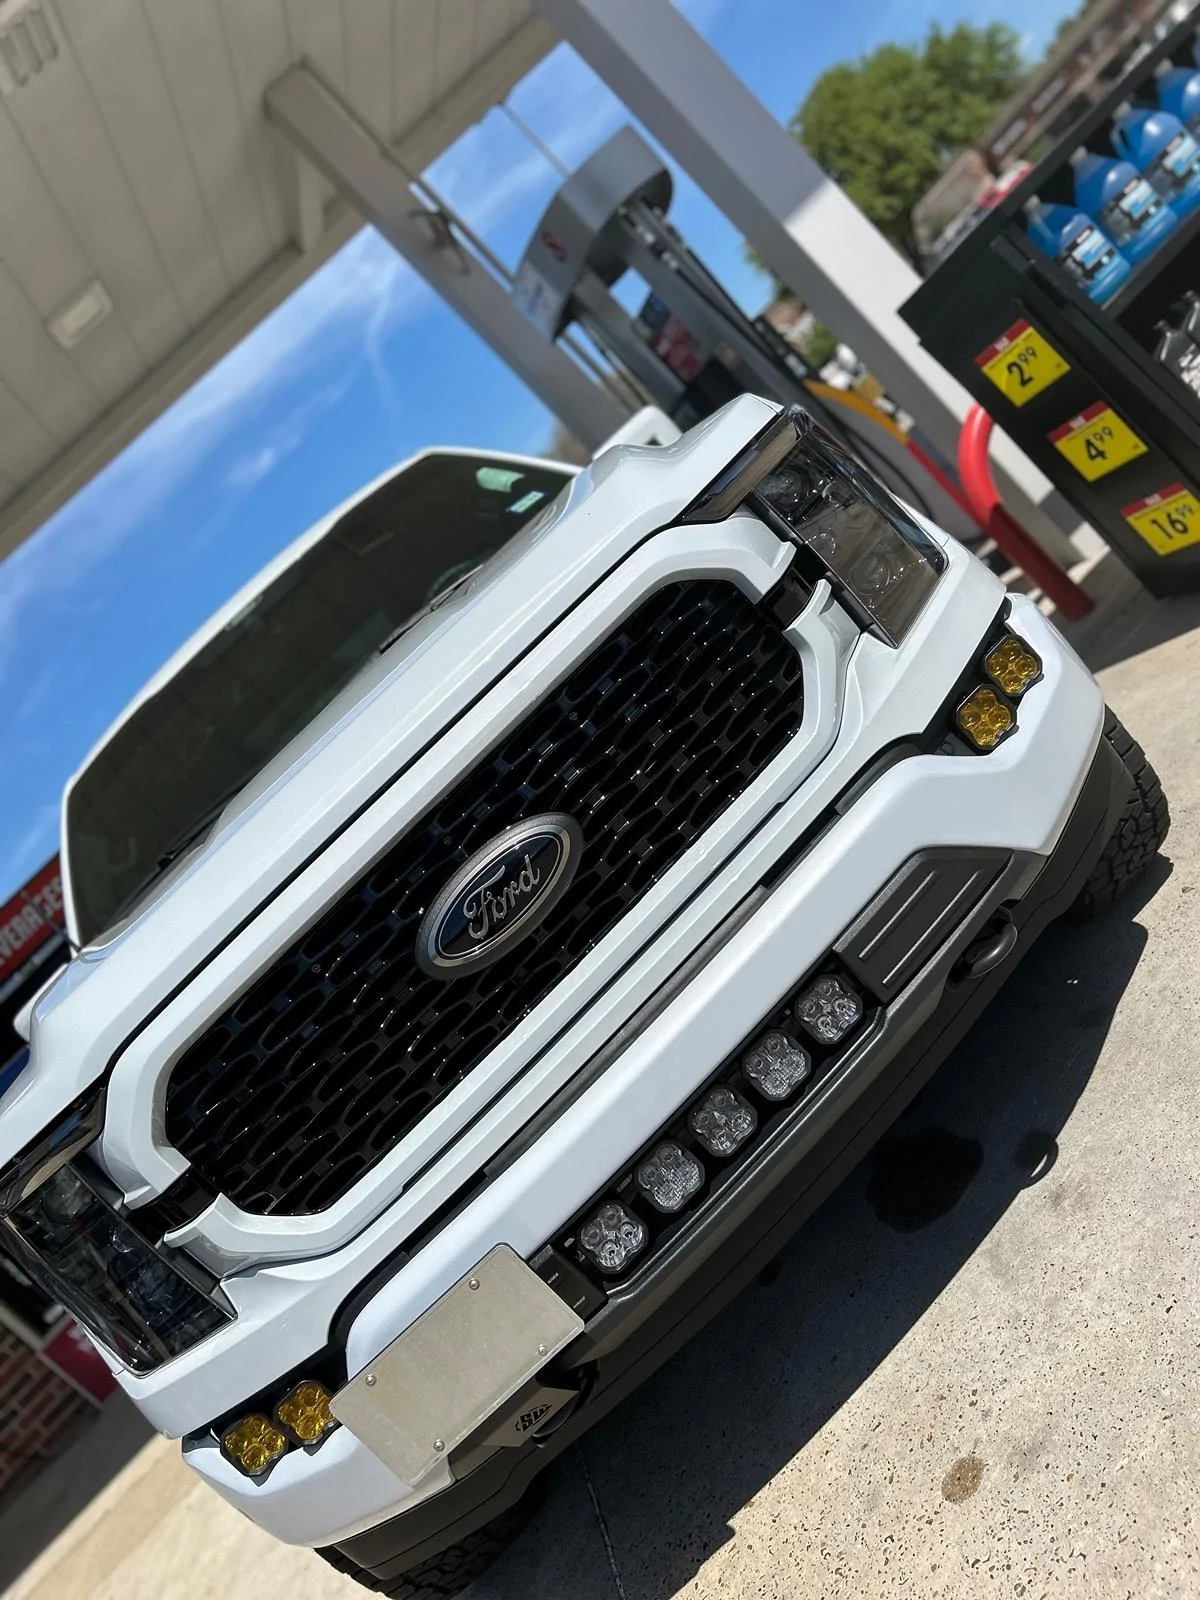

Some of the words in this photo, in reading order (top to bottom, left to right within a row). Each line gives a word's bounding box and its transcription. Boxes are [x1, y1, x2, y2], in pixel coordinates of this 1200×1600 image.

[1006, 345, 1038, 388] 299
[1083, 426, 1114, 462] 499
[463, 854, 540, 940] Ford
